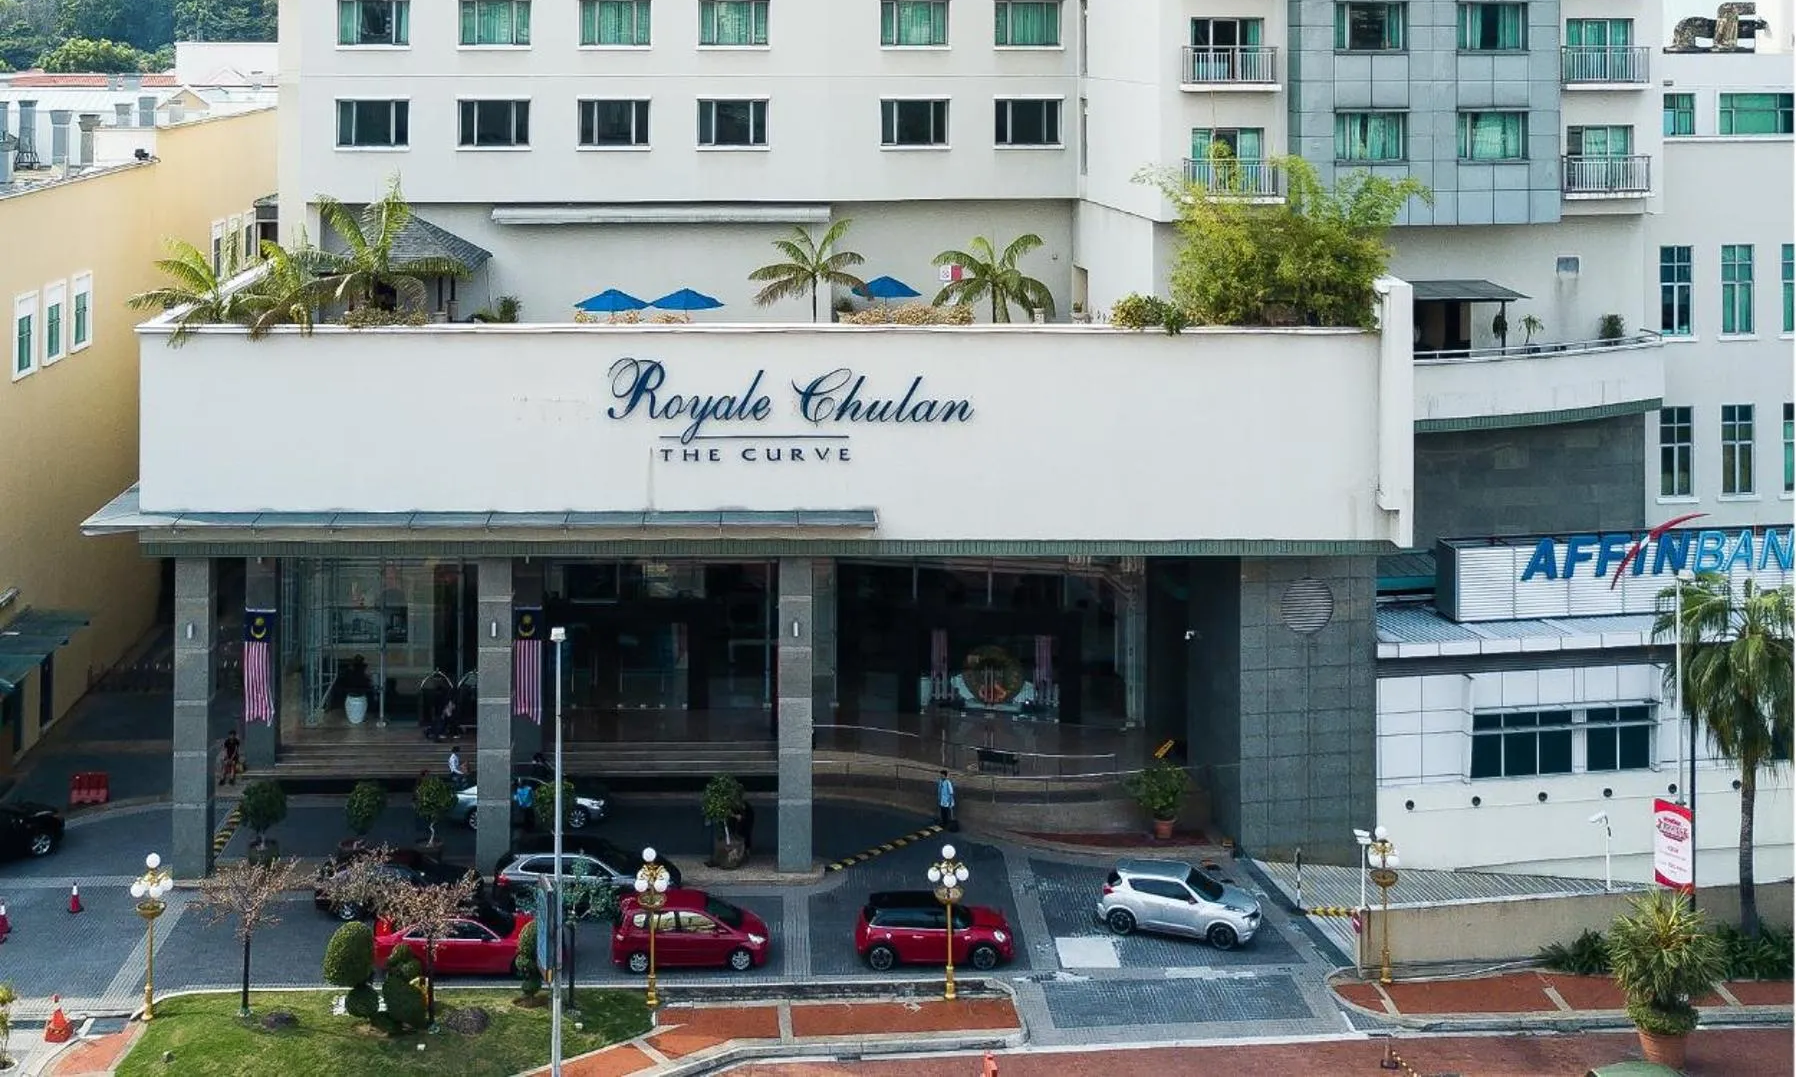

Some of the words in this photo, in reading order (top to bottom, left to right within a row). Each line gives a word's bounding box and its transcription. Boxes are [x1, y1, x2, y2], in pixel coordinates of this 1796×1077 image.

[607, 357, 771, 445] Royale
[791, 368, 975, 427] Chulan
[661, 448, 720, 462] THE
[741, 448, 852, 462] CURVE
